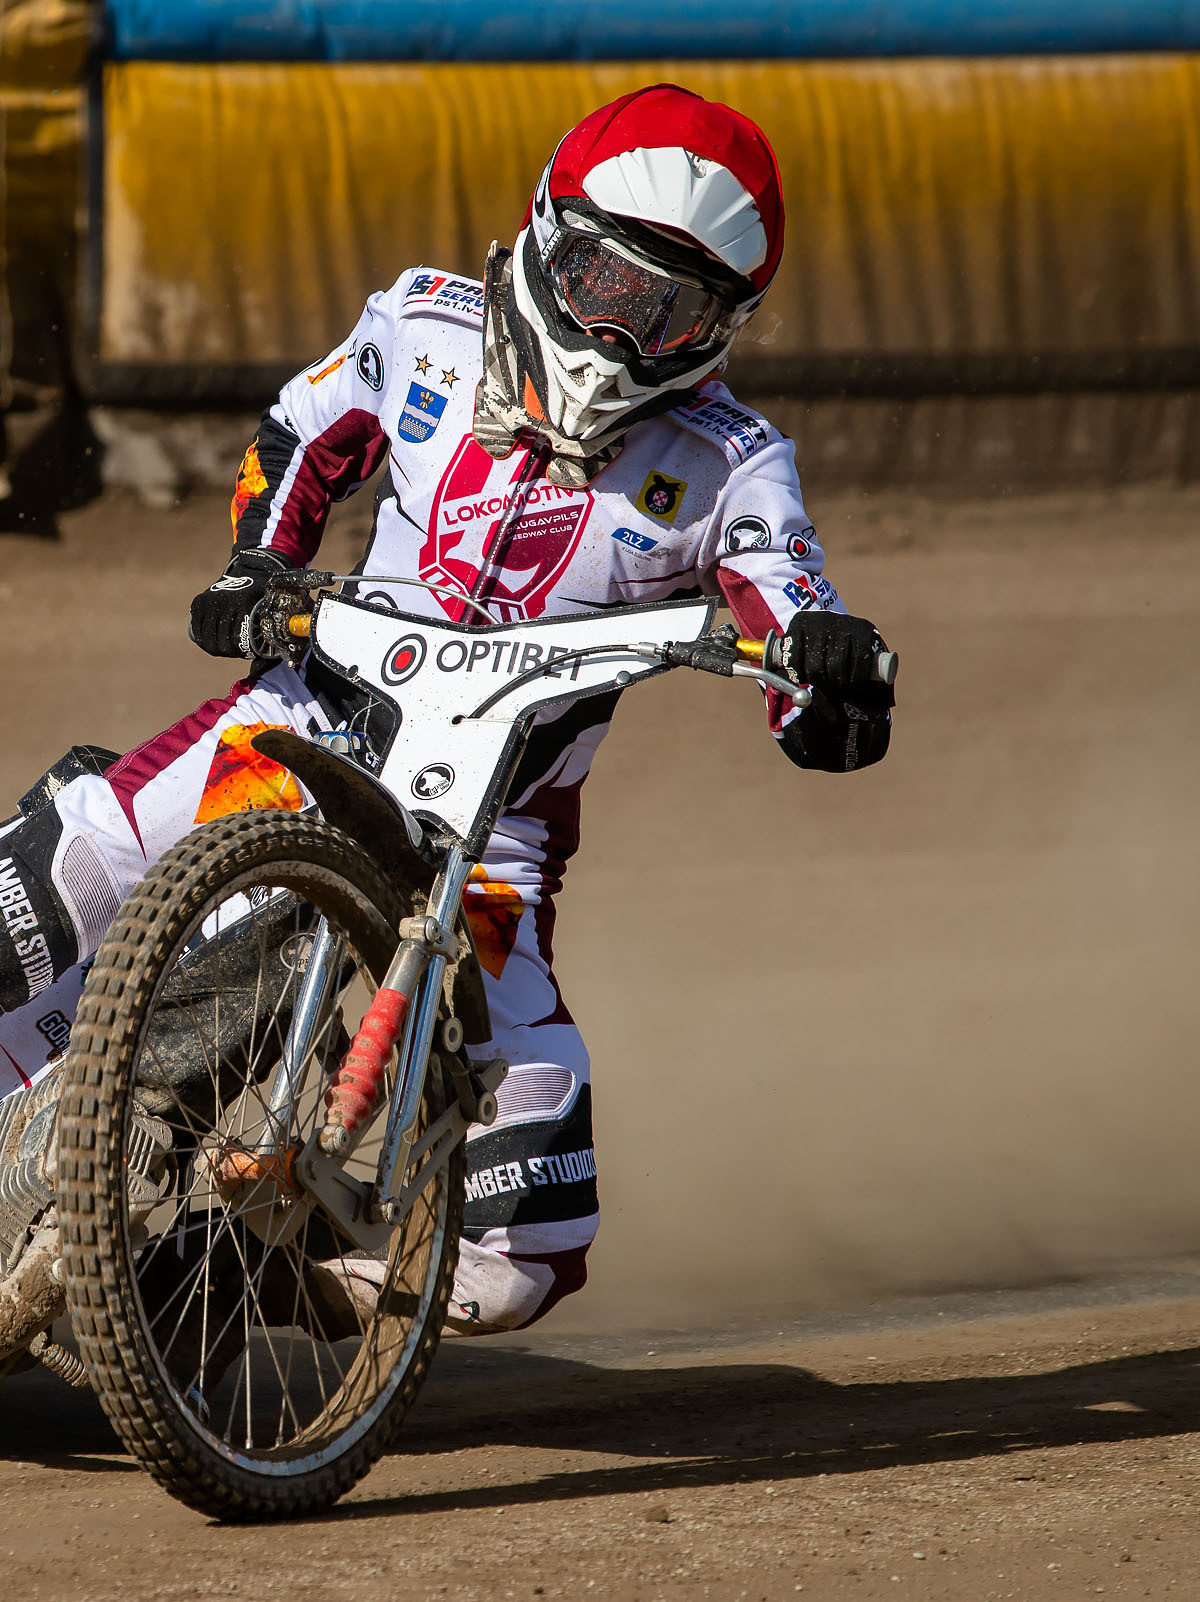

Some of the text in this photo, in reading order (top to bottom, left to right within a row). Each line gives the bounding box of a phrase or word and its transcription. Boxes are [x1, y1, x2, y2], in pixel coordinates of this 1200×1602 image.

[437, 289, 484, 308] SERV
[445, 280, 484, 299] PA
[433, 299, 474, 313] ps1.lv
[688, 416, 724, 435] ps1.lv
[707, 401, 768, 442] PART
[549, 524, 573, 534] CLUB
[436, 640, 589, 681] OPTIBET
[14, 933, 54, 1000] STUDIO
[464, 1161, 528, 1203] MBER
